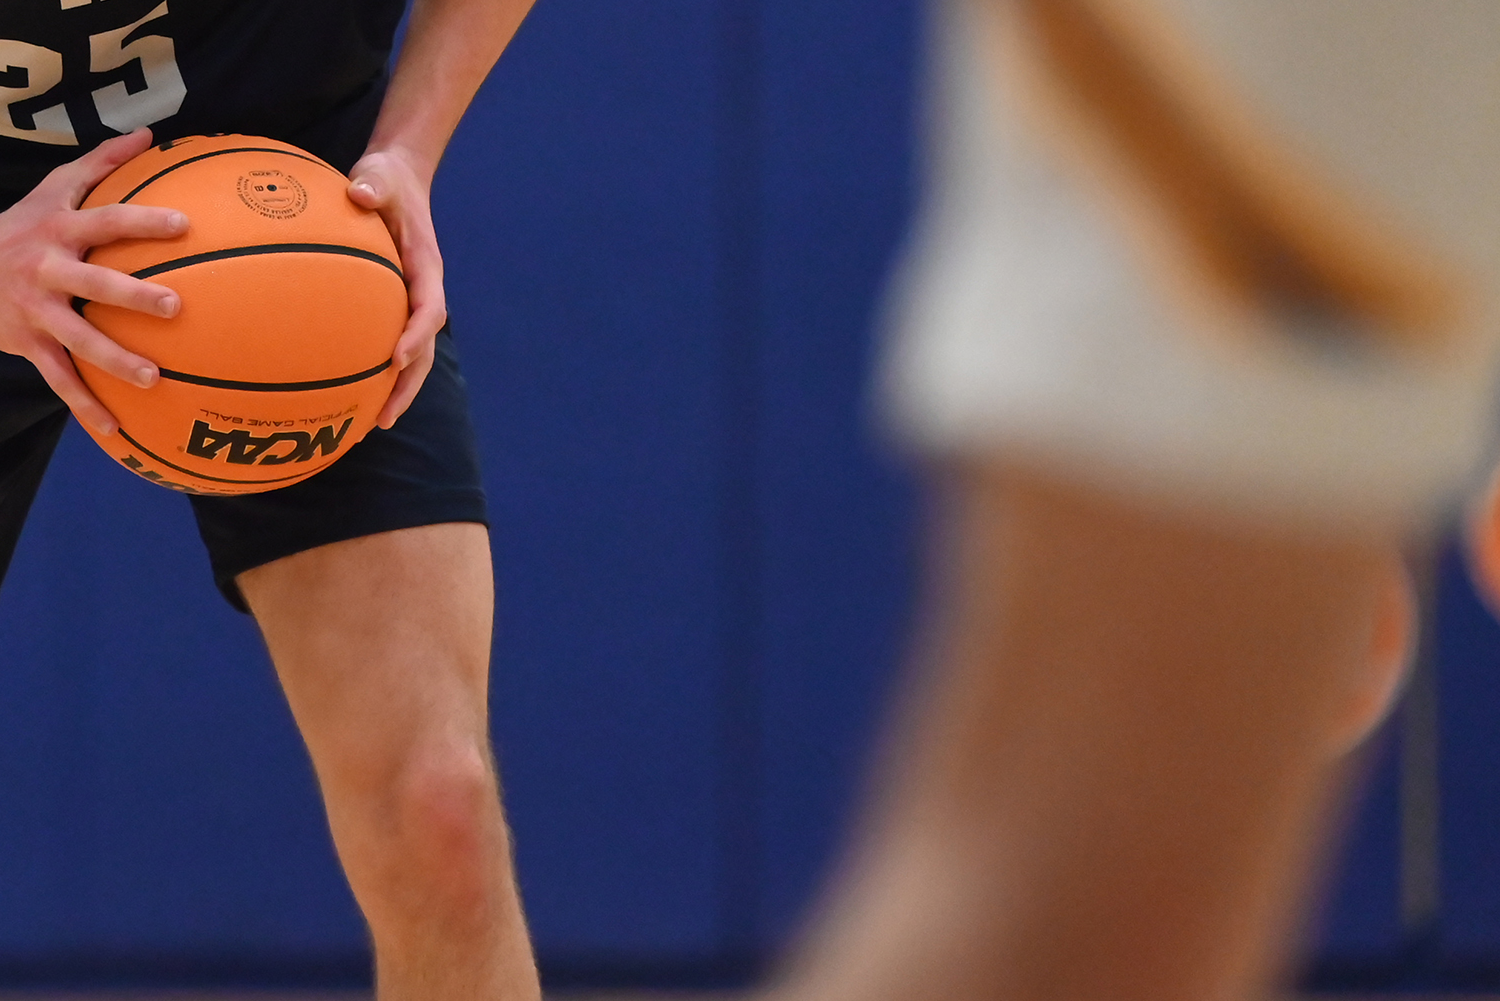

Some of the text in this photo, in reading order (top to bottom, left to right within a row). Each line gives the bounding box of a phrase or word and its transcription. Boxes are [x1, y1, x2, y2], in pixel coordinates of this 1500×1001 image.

[200, 403, 359, 428] OFFICIAL GAME BALL
[185, 416, 355, 466] NCAA
